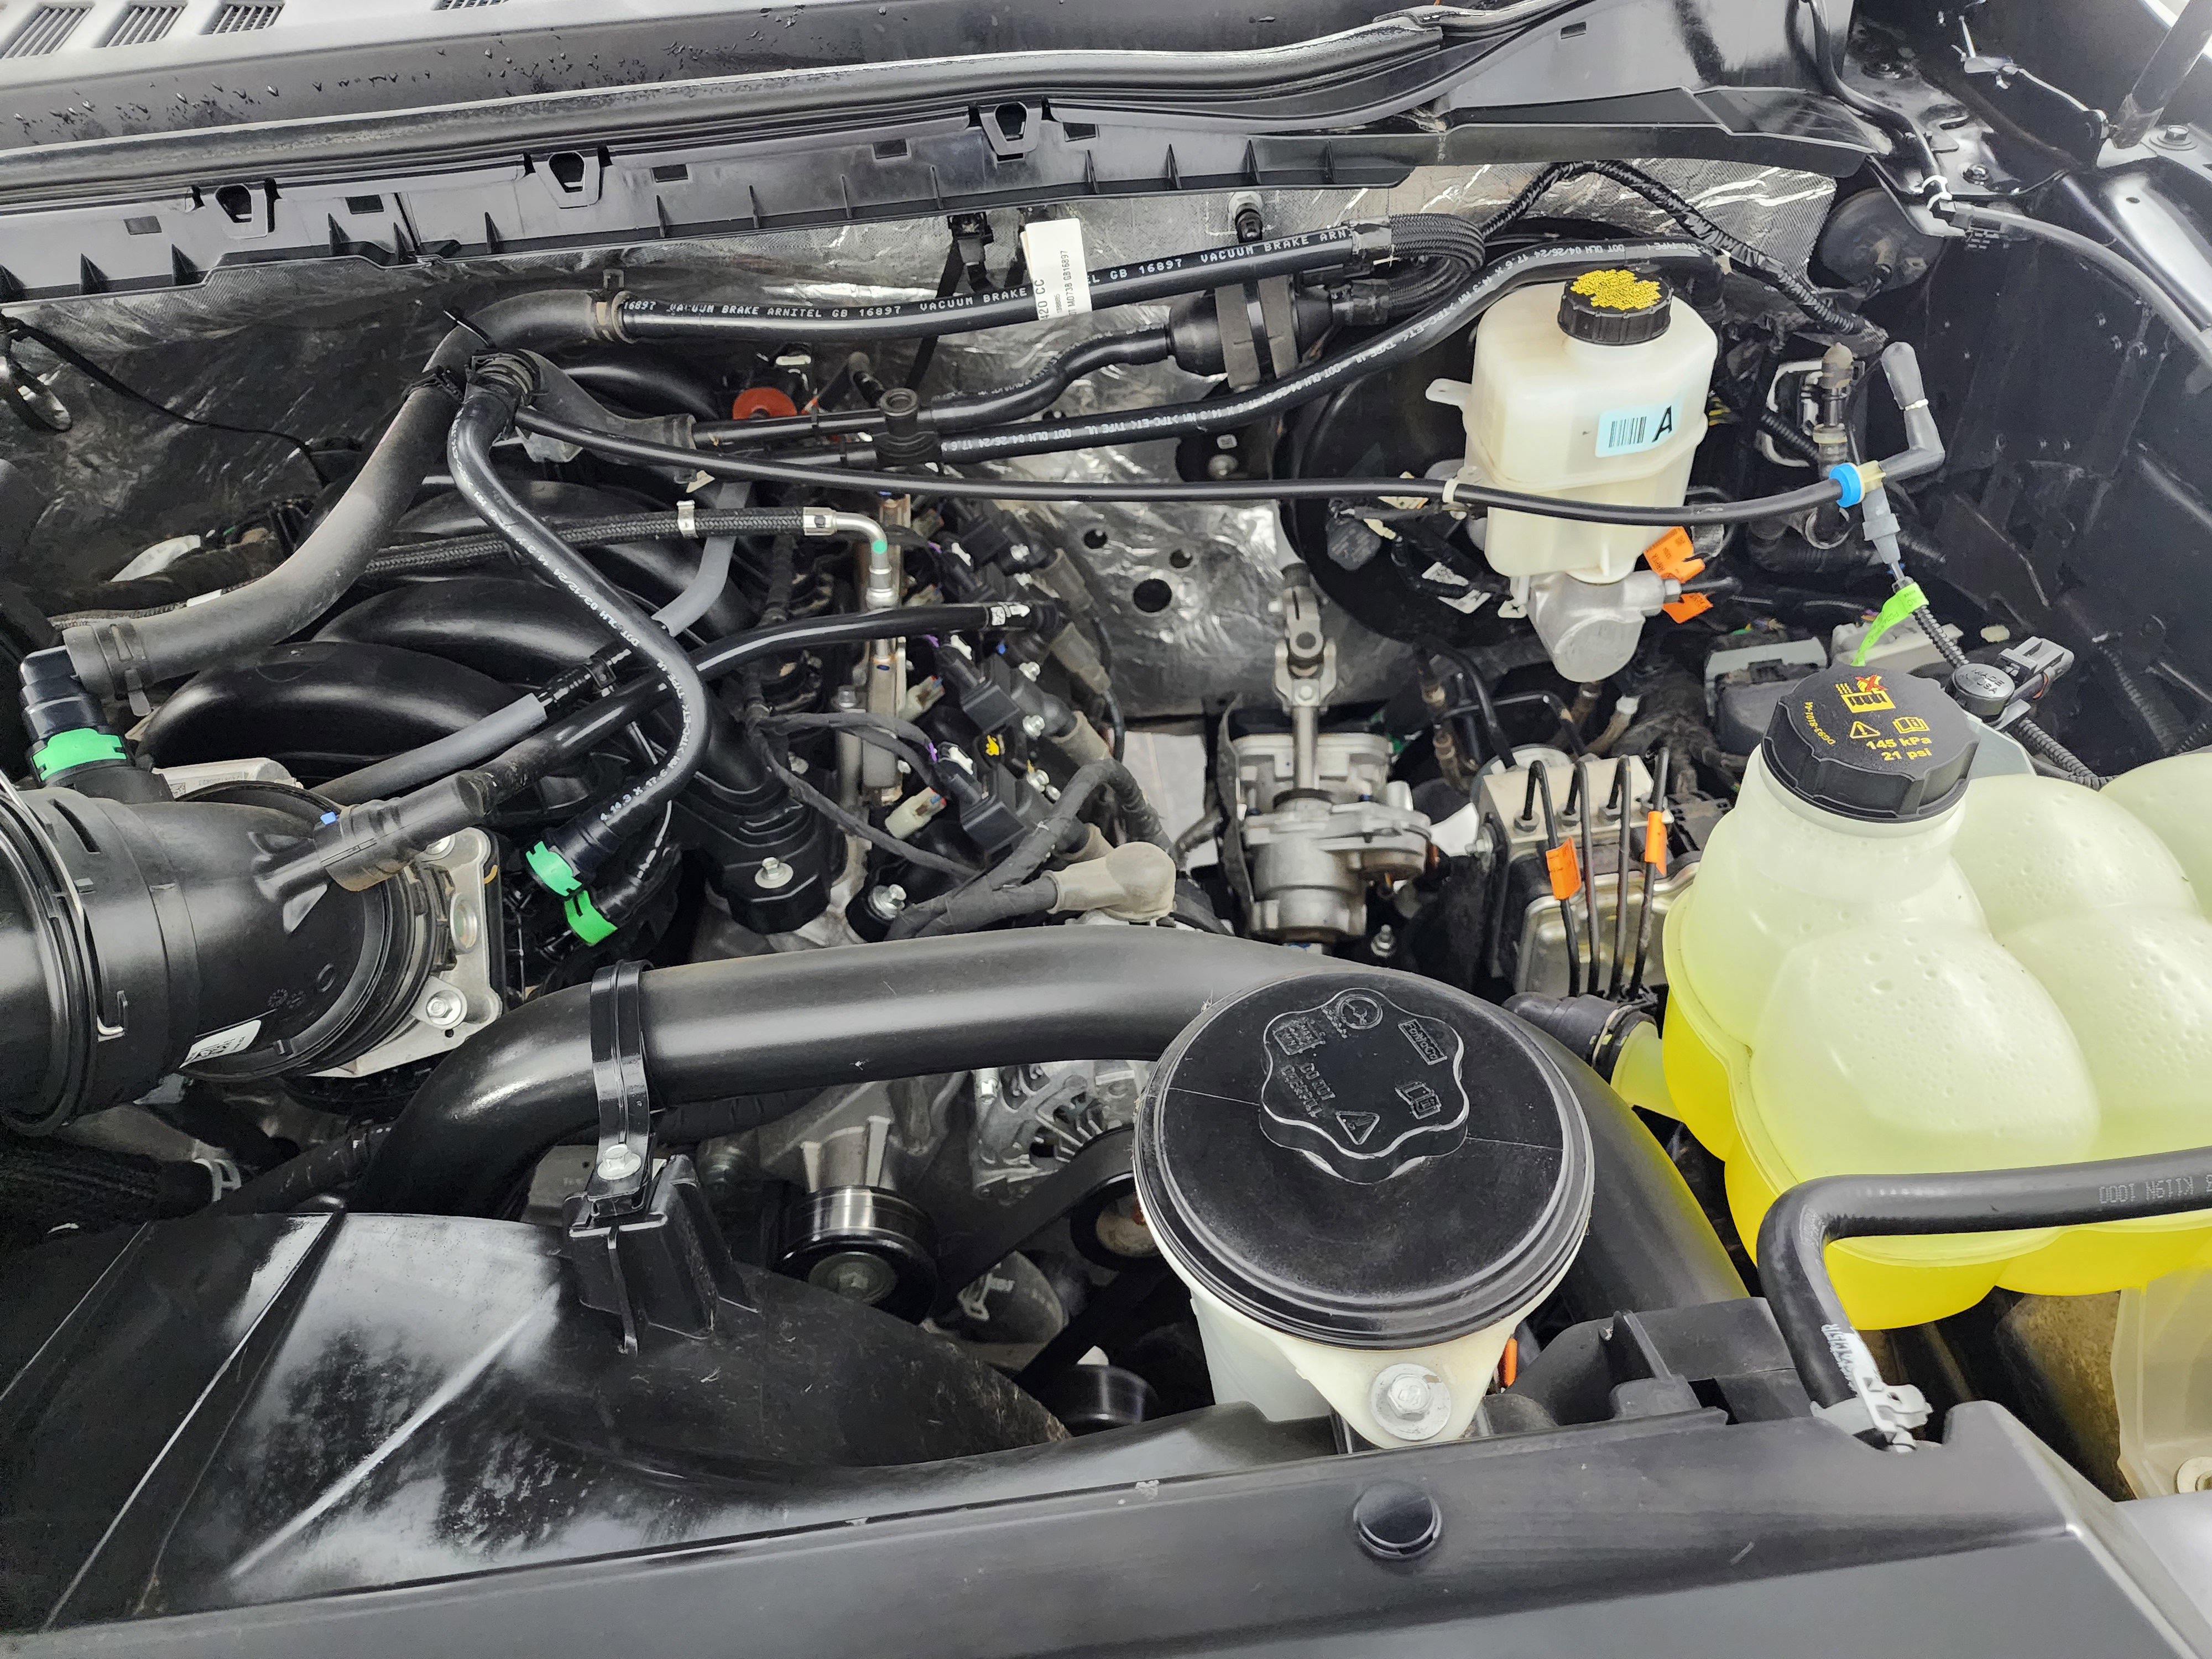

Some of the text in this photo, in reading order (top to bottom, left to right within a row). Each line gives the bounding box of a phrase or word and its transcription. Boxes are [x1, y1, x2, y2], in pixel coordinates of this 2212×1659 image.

[1585, 245, 1604, 255] DLH
[1607, 244, 1625, 253] DOT
[1110, 268, 1128, 280] GB
[1139, 258, 1183, 275] 16897
[1200, 246, 1255, 264] VACUUM
[1264, 237, 1310, 253] BRAKE
[1505, 253, 1529, 269] 17.6
[1495, 267, 1504, 277] X
[1034, 279, 1046, 295] CC
[1472, 276, 1493, 294] 14.3
[624, 300, 656, 311] 16897
[721, 304, 760, 315] BRAKE
[767, 306, 822, 317] ARNITEL
[832, 310, 848, 319] GB
[859, 306, 902, 317] 16897
[919, 296, 974, 312] VACUUM
[983, 287, 1027, 304] BRAKE
[1458, 291, 1472, 305] MM
[1084, 425, 1099, 435] UL
[1101, 422, 1126, 434] TYPE
[1651, 405, 1673, 443] A
[1029, 431, 1048, 442] DLH
[1053, 428, 1072, 440] DOT
[473, 491, 488, 507] MM
[553, 568, 599, 611] 03/12/24
[1971, 668, 2006, 687] MADE
[667, 672, 685, 700] TYPE
[1976, 678, 1998, 694] USA
[1803, 701, 1836, 747] DG93-8101-AA
[1866, 735, 1933, 750] 145 kPa
[667, 755, 681, 769] MM
[1881, 748, 1933, 761] 21 psi
[645, 769, 668, 787] 17.6
[633, 786, 643, 796] X
[1300, 1062, 1320, 1080] DO
